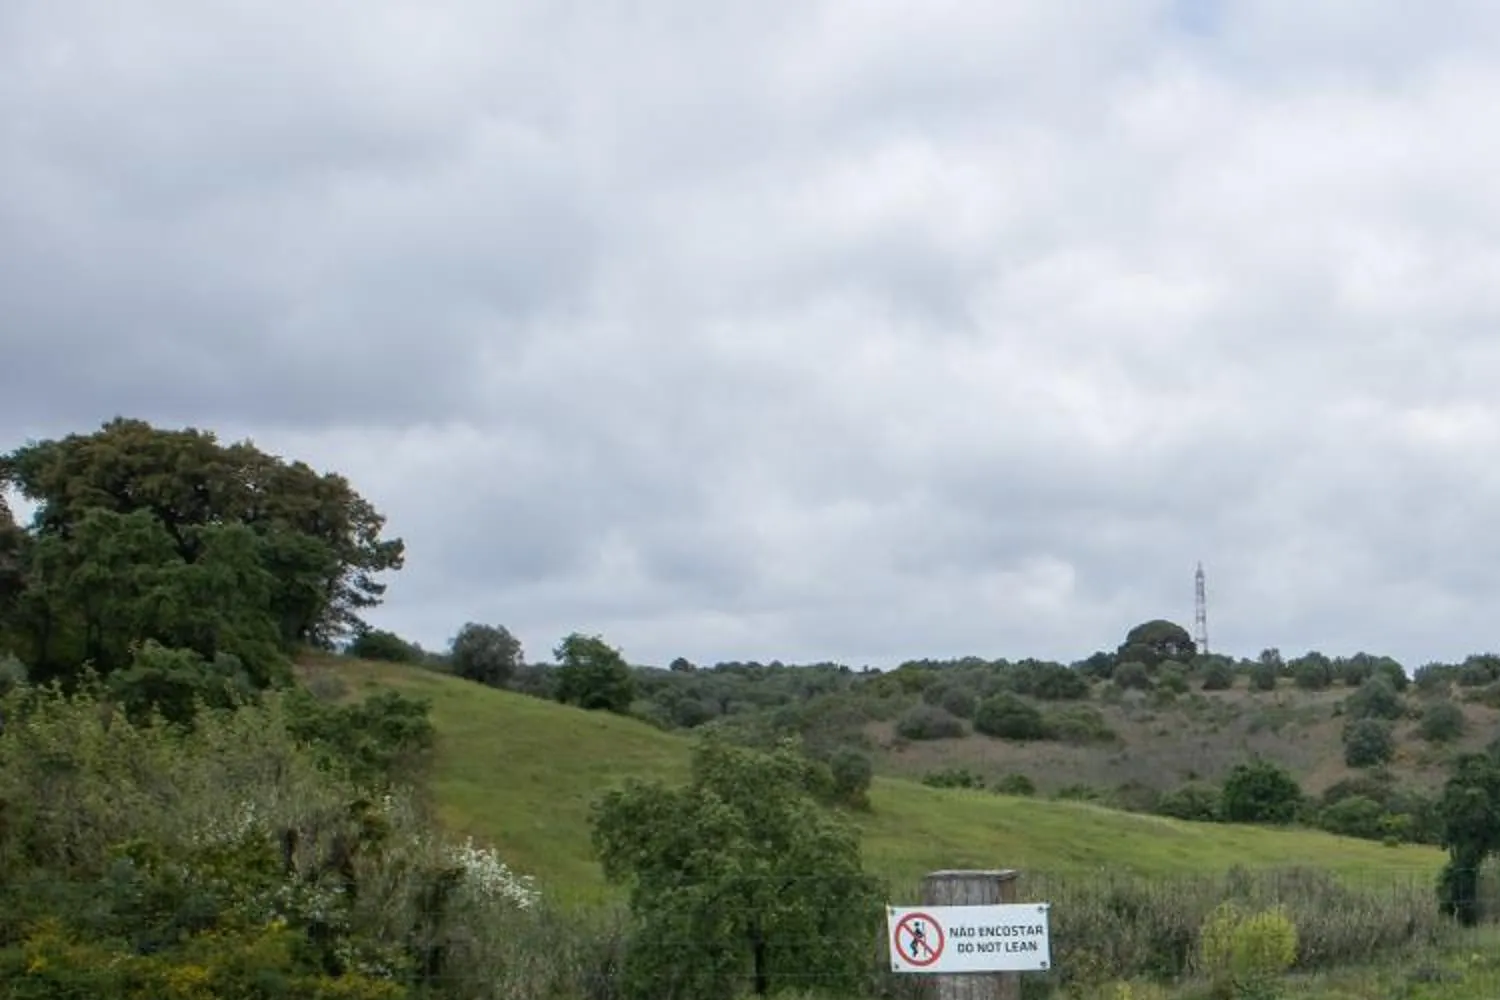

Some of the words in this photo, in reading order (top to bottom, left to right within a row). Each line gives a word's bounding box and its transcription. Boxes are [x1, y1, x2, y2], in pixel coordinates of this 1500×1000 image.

[978, 925, 1043, 936] ENCOSTAR
[957, 943, 974, 953] DO
[977, 942, 1001, 953] NOT
[1005, 941, 1038, 953] LEAN
